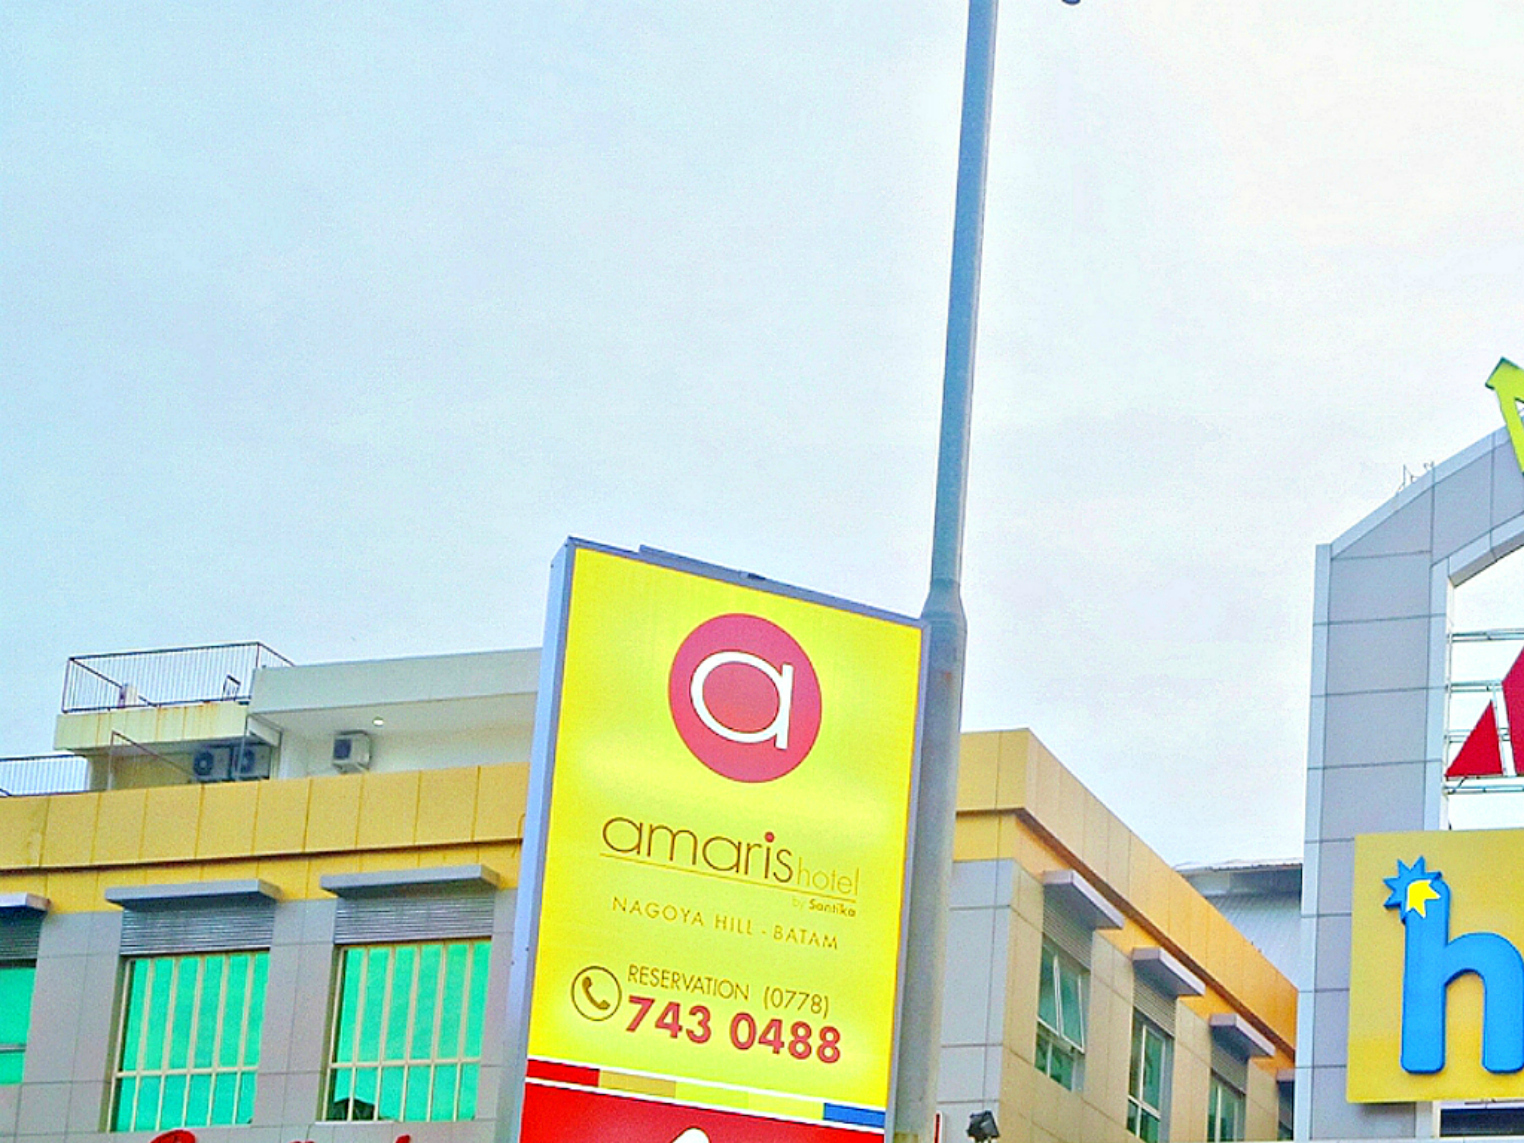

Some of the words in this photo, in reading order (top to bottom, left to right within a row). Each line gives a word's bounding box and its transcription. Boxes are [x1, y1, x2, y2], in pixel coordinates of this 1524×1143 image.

[602, 816, 794, 884] amaris
[797, 856, 860, 896] hotel
[612, 896, 705, 928] NAGOYA
[714, 913, 753, 936] HILL
[773, 924, 838, 950] BATAM
[808, 898, 857, 918] Santika
[627, 963, 750, 1001] RESERVATION
[763, 986, 830, 1020] (0778)
[625, 995, 713, 1044] 743
[730, 1012, 841, 1064] 0488
